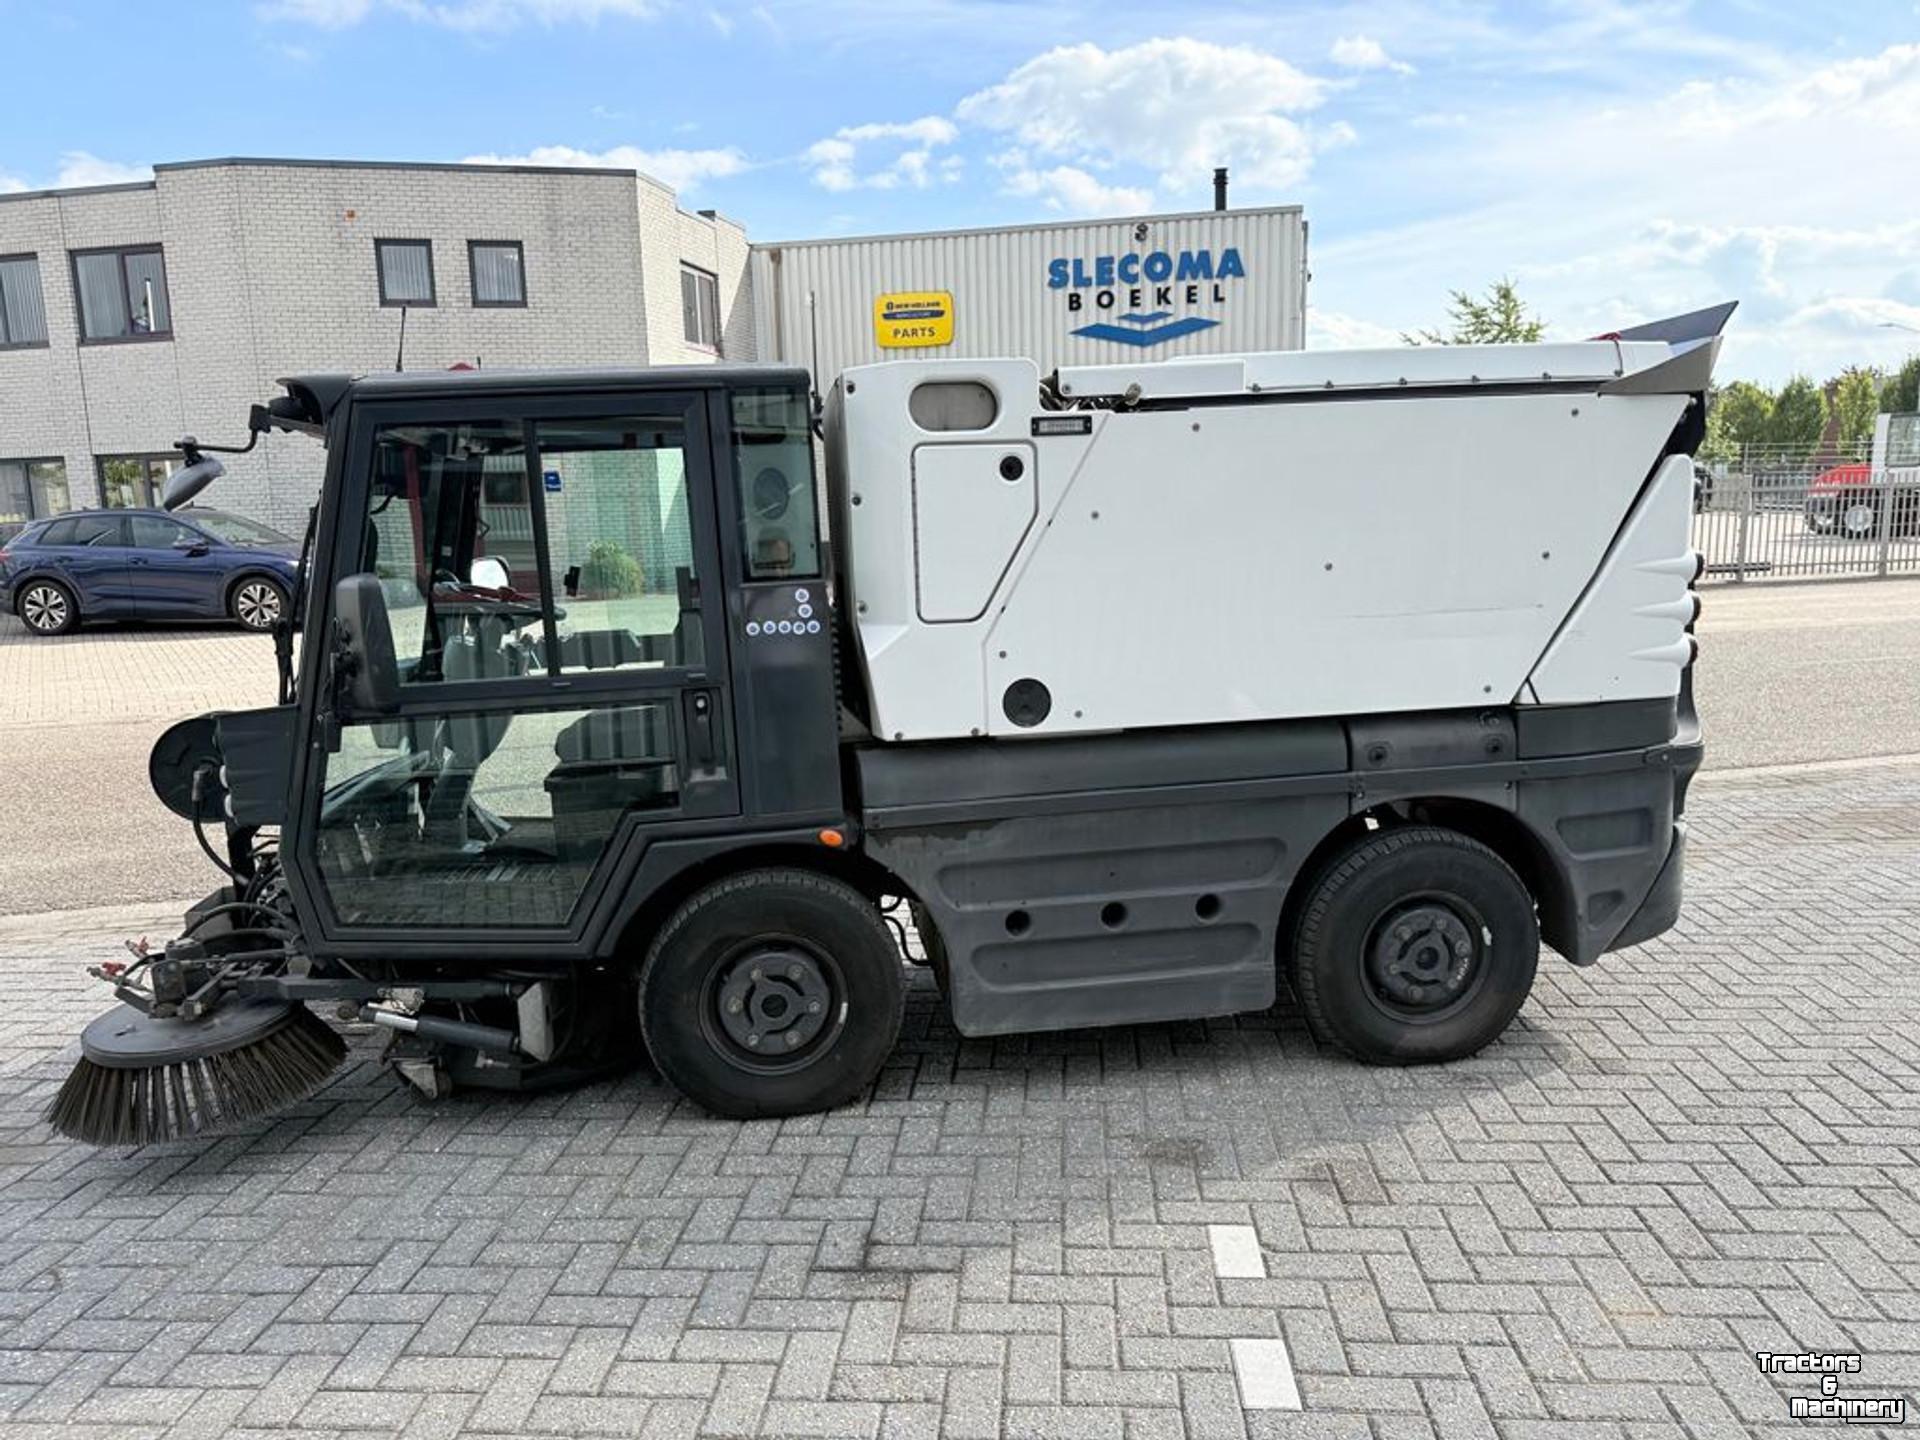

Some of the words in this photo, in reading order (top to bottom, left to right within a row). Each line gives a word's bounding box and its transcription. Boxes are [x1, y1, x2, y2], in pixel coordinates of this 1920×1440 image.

[1048, 248, 1245, 289] SLECOMA
[1068, 284, 1226, 311] BOEKEL
[893, 326, 936, 338] PARTS
